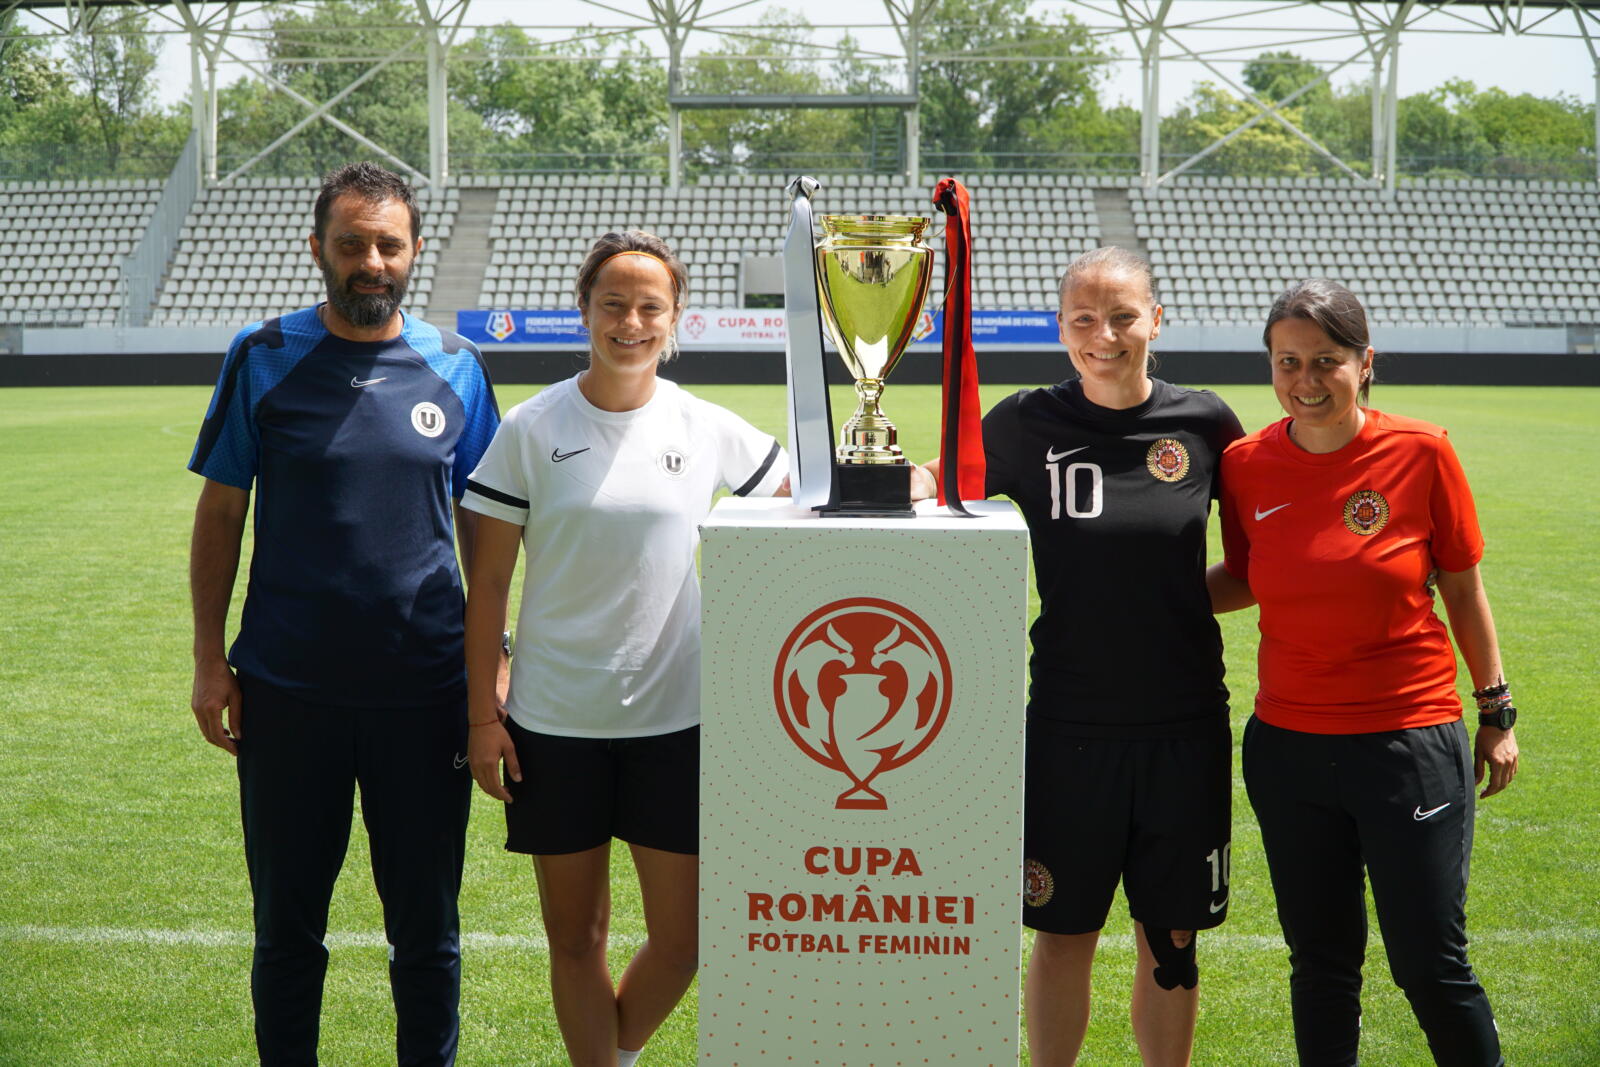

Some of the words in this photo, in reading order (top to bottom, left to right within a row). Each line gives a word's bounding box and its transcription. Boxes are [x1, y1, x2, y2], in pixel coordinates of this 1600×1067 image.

[718, 317, 756, 328] CUPA
[420, 411, 436, 429] U
[665, 455, 681, 472] U
[1045, 462, 1104, 520] 10
[804, 846, 923, 876] CUPA
[747, 884, 974, 924] ROMÂNIEI
[748, 932, 850, 953] FOTBAL
[858, 934, 970, 955] FEMININ
